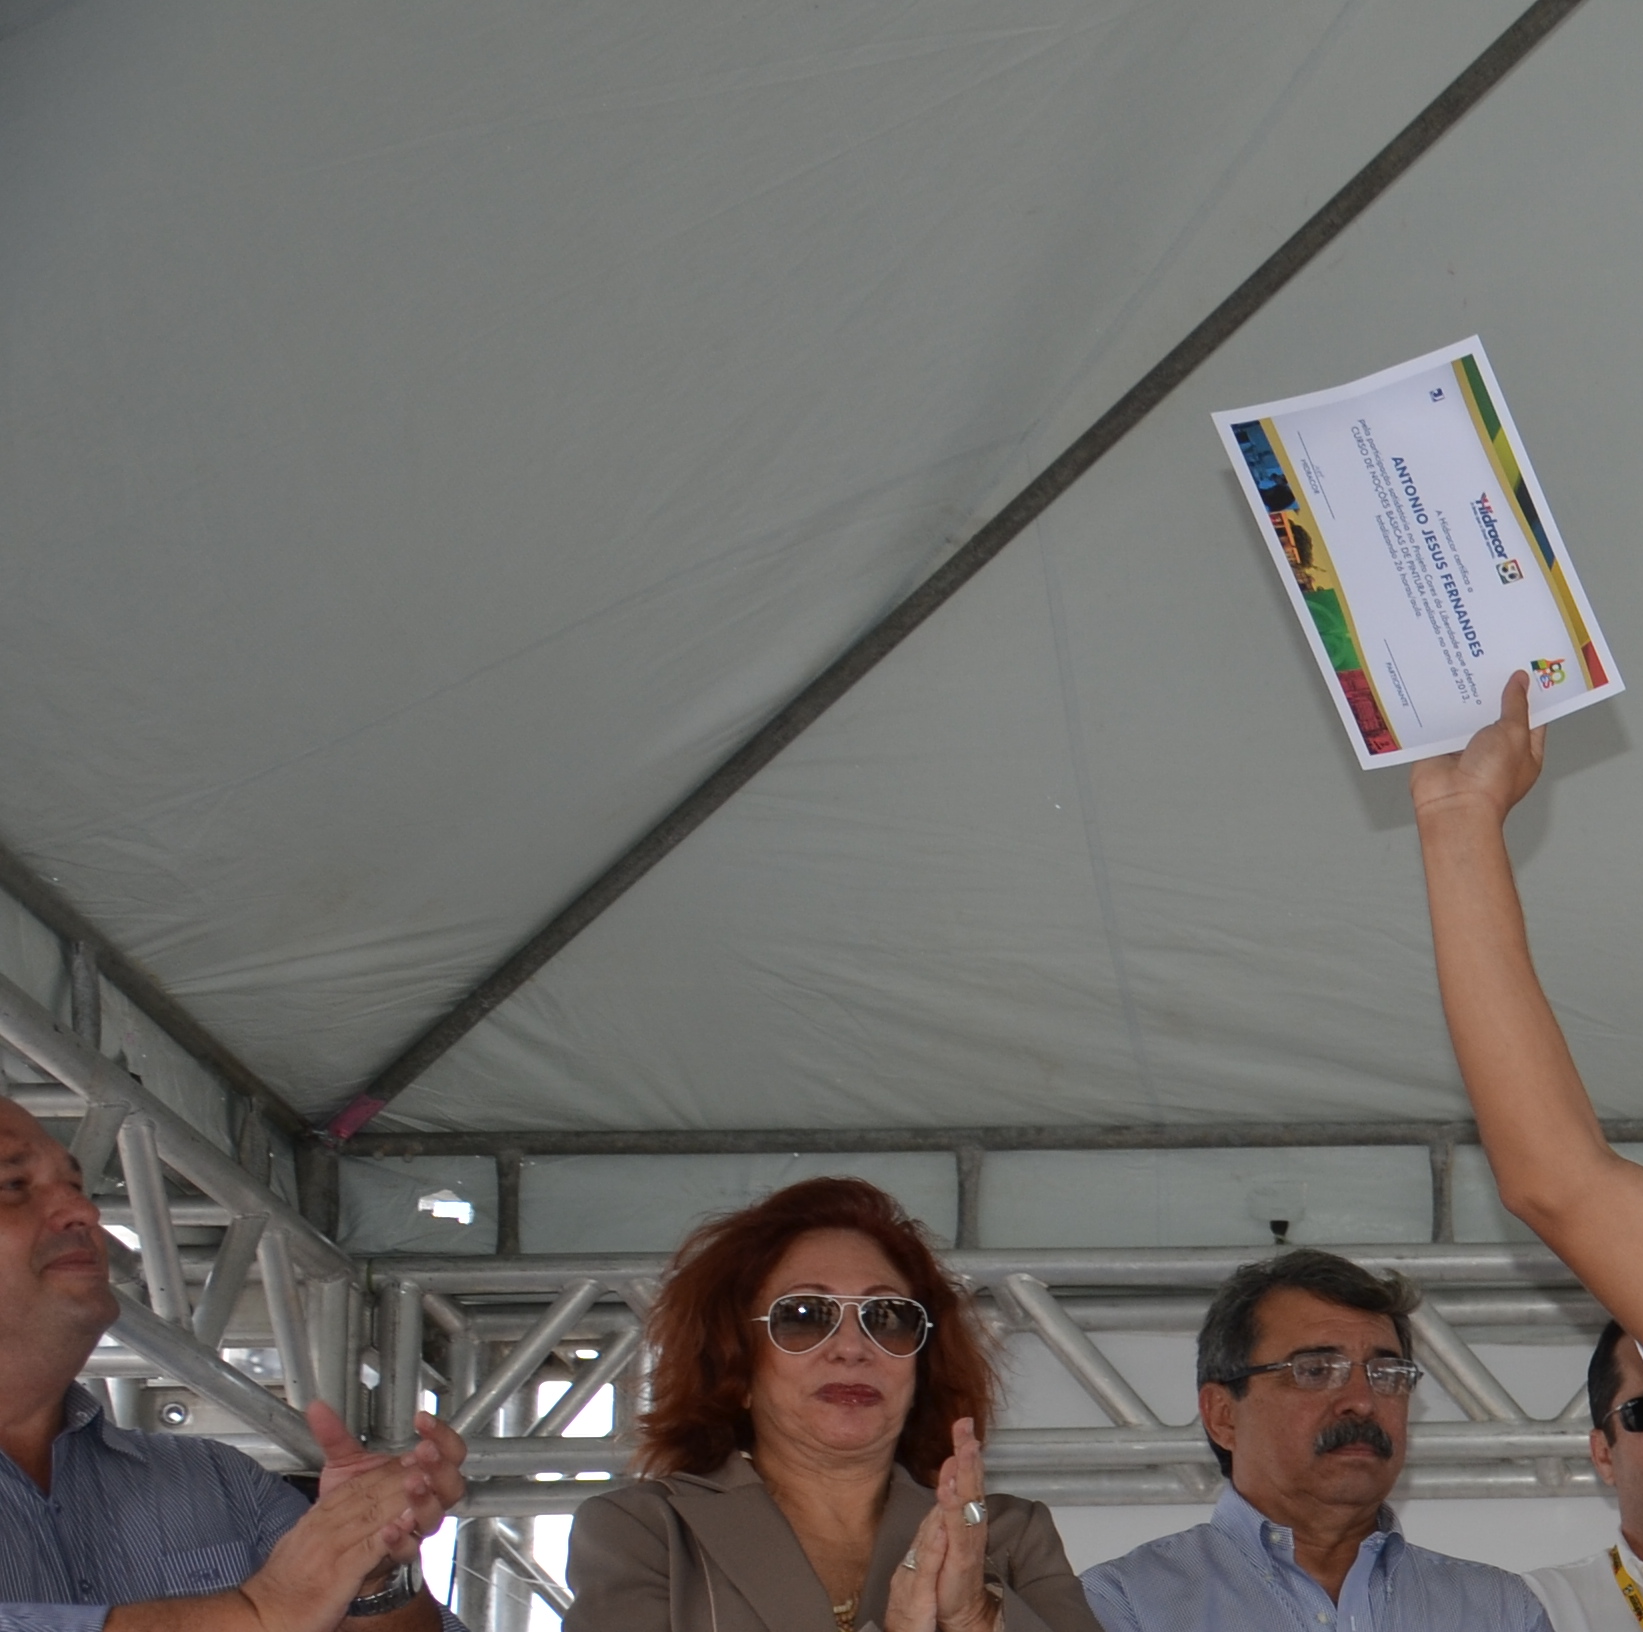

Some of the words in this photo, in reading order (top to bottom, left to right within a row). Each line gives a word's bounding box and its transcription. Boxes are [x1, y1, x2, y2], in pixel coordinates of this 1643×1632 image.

[1350, 425, 1368, 456] CURSO
[1363, 457, 1374, 469] DE
[1369, 470, 1390, 509] NOÇÕES
[1385, 509, 1406, 545] BÁSICAS
[1400, 546, 1411, 558] DE
[1406, 559, 1425, 596] PINTURA
[1438, 517, 1457, 552] Hidracor
[1475, 492, 1508, 559] Hidracor
[1391, 457, 1428, 524] ANTONIO
[1421, 529, 1448, 570] JESUS
[1440, 573, 1484, 657] FERNANDES
[1411, 544, 1427, 572] Projeto
